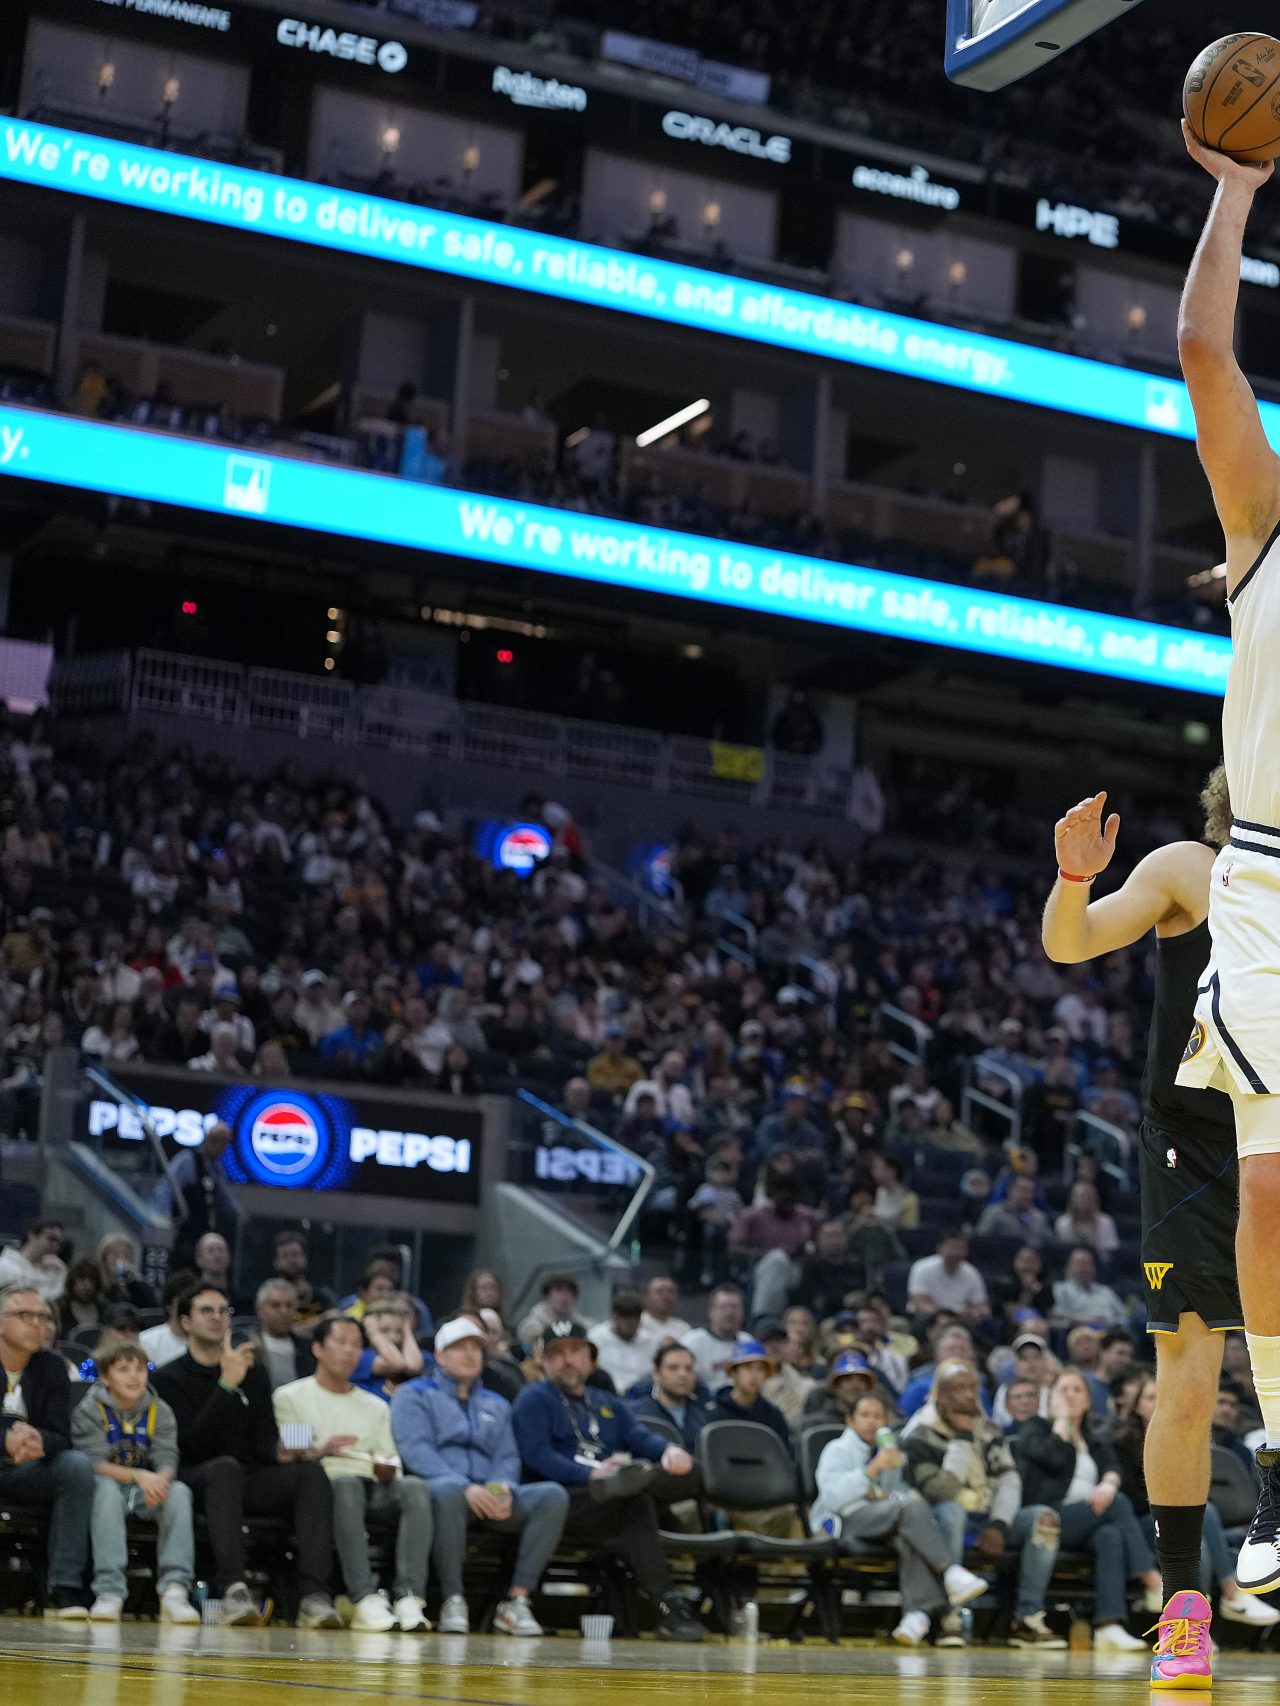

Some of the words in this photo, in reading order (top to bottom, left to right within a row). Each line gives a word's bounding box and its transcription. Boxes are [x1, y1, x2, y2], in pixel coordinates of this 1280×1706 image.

[276, 18, 378, 65] CHASE
[661, 110, 791, 164] ORACLE
[1035, 197, 1119, 249] HPE
[5, 125, 110, 181] We're
[119, 158, 265, 223] working
[273, 187, 307, 224] to
[315, 196, 437, 249] deliver
[443, 229, 524, 274] safe,
[532, 248, 667, 307] reliable,
[673, 280, 735, 317] and
[739, 293, 899, 355] affordable
[904, 333, 1014, 385] energy.
[459, 501, 563, 556] We're
[570, 530, 711, 591] working
[718, 554, 752, 590] to
[759, 559, 876, 611] deliver
[881, 588, 959, 634] safe,
[1100, 630, 1158, 667] and
[1161, 638, 1232, 678] affor
[349, 1128, 471, 1173] PEPSI
